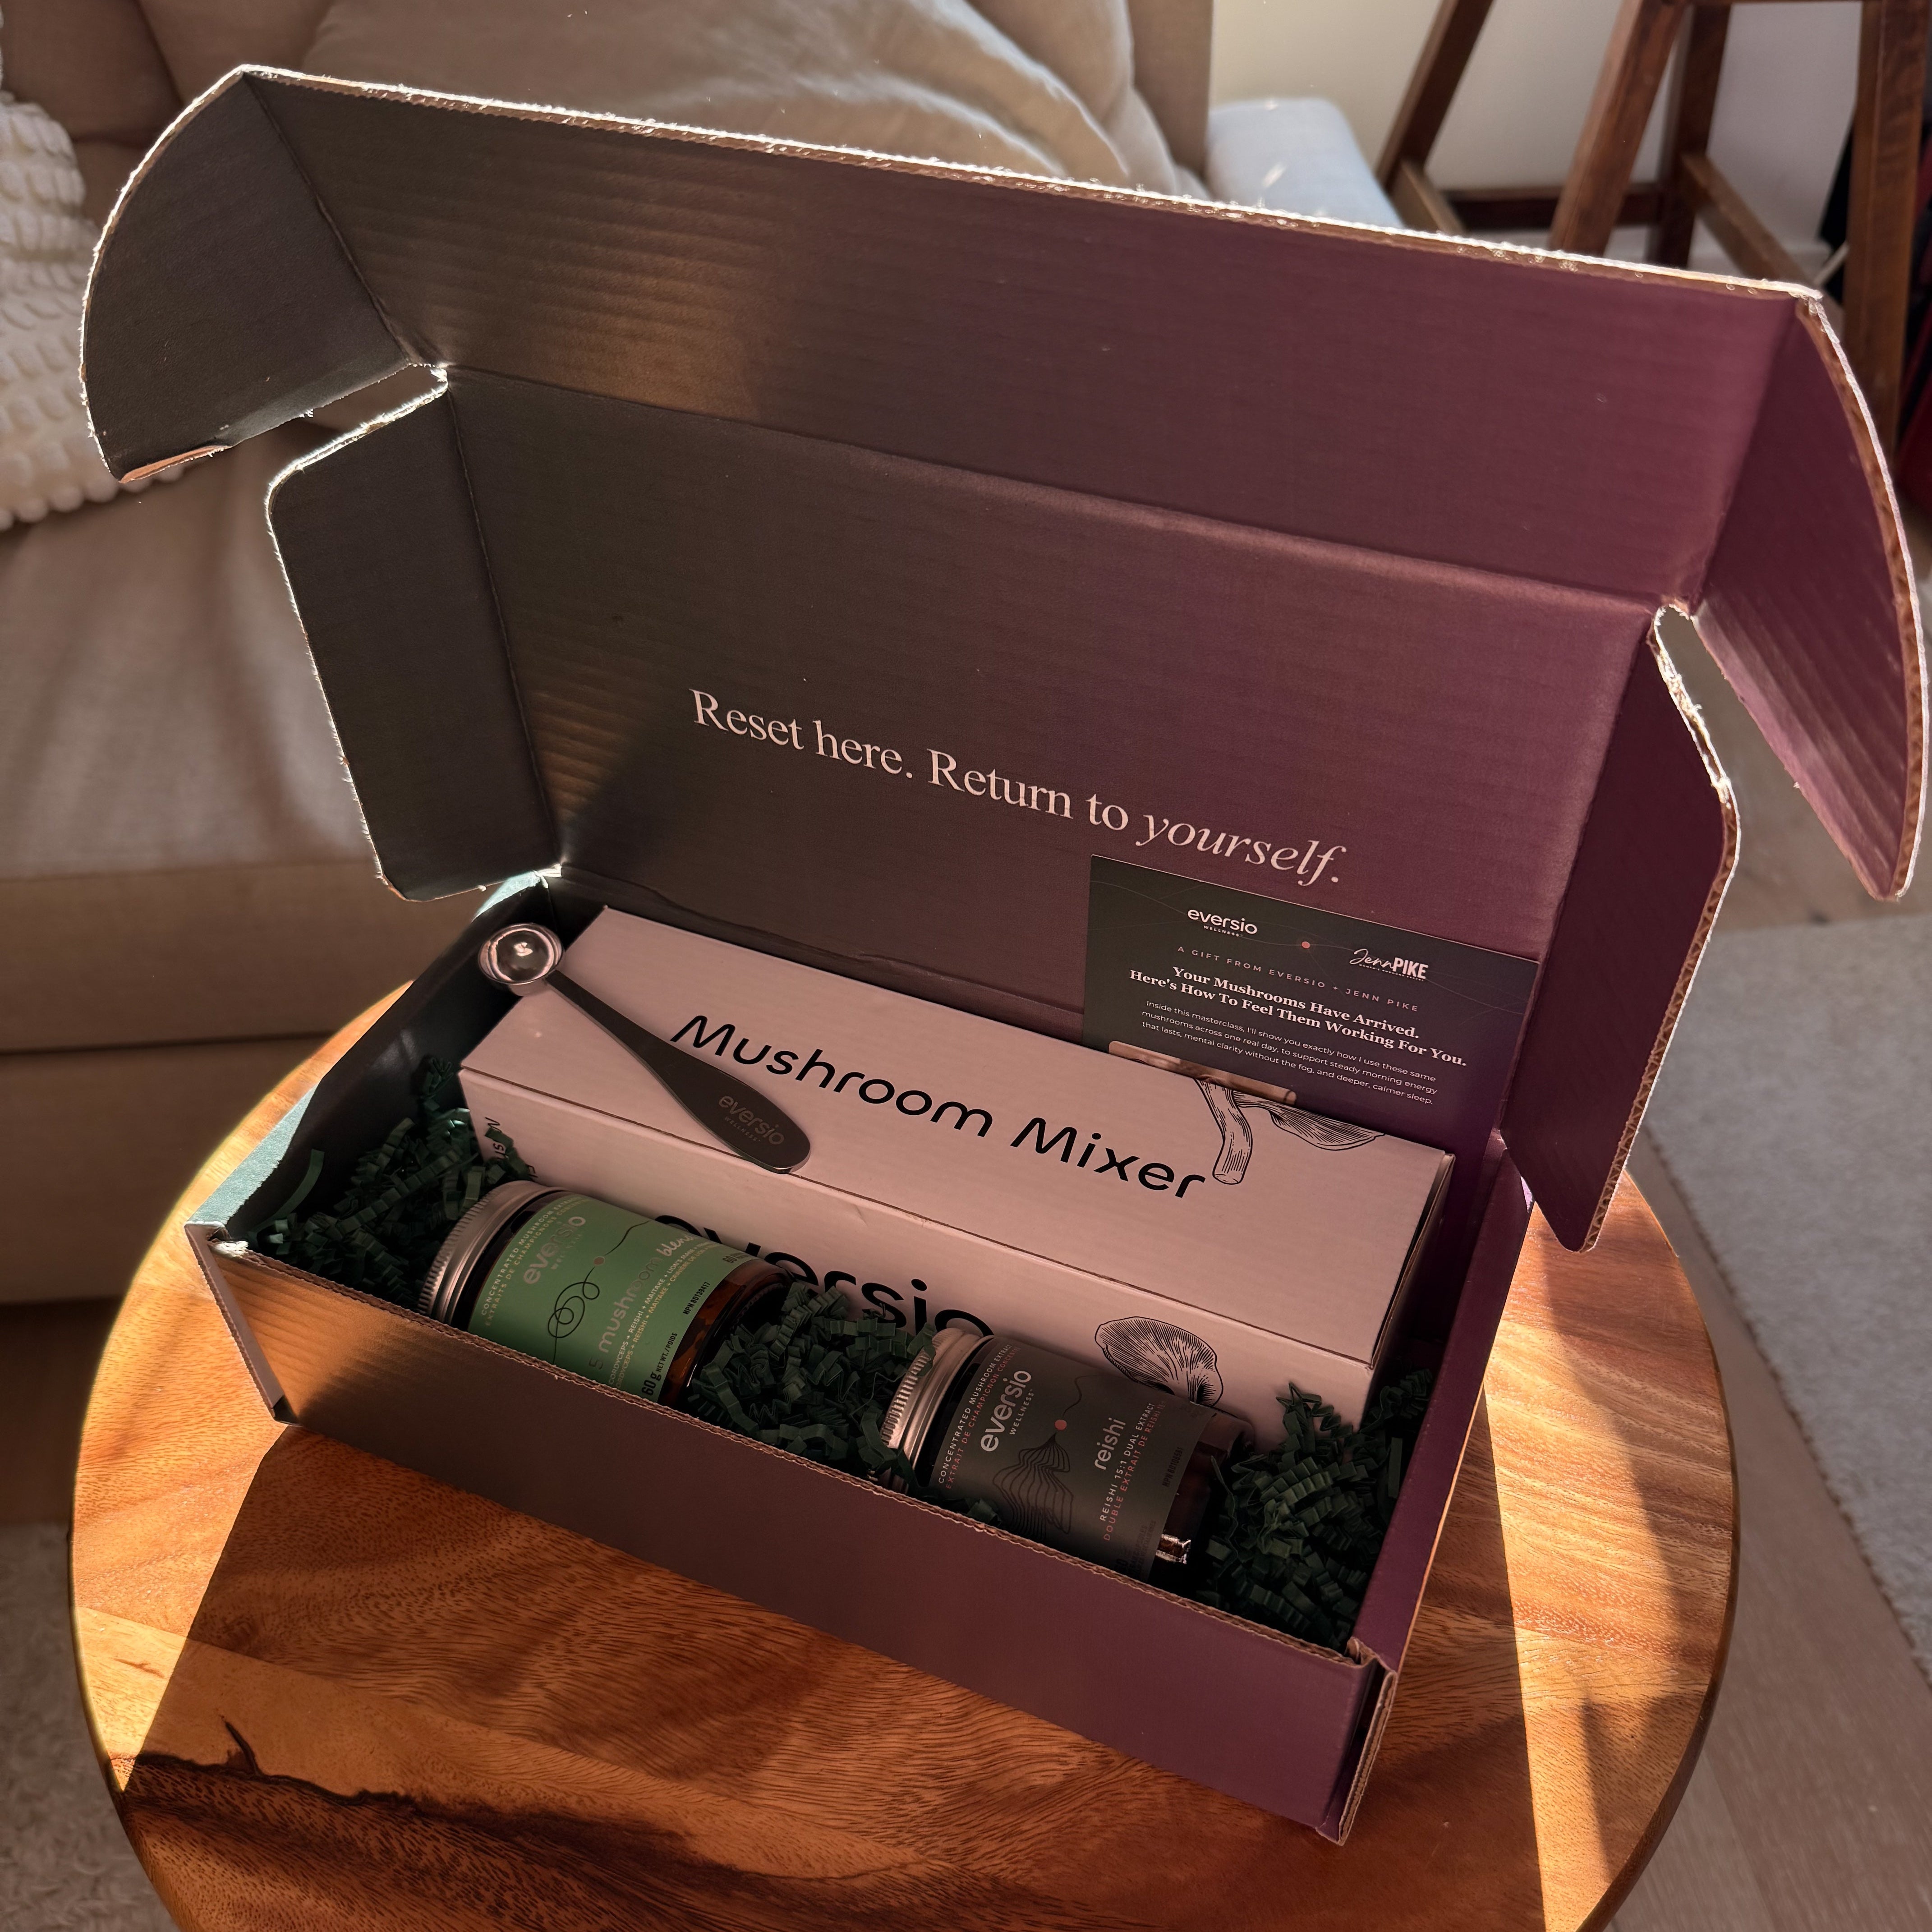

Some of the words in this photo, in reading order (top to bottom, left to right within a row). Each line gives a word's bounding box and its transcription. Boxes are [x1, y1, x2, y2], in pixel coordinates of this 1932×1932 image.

[690, 688, 804, 750] Reset
[813, 720, 913, 778] here.
[927, 749, 1074, 819] Return
[1086, 793, 1128, 830] to
[1136, 813, 1346, 886] yourself.
[1188, 910, 1257, 934] eversio
[1130, 970, 1177, 990] Here's
[1181, 983, 1216, 1000] How
[1219, 993, 1237, 1006] To
[1242, 999, 1273, 1016] Feel
[1277, 1009, 1320, 1028] Them
[1325, 1021, 1394, 1049] Working
[1398, 1040, 1427, 1055] For
[1430, 1048, 1466, 1066] You.
[1173, 966, 1210, 984] Your
[1214, 977, 1306, 1009] Mushrooms
[1309, 1002, 1350, 1020] Have
[1353, 1014, 1419, 1039] Arrived.
[1192, 950, 1219, 961] GIFT
[1227, 958, 1261, 972] FROM
[1269, 969, 1325, 988] EVERSIO
[1346, 989, 1379, 1002] JENN
[1387, 999, 1418, 1012] PIKE
[1142, 1011, 1193, 1029] mushrooms
[1195, 1026, 1222, 1037] across
[1224, 1033, 1241, 1042] one
[1243, 1038, 1259, 1046] real
[1293, 1052, 1328, 1065] support
[1330, 1061, 1360, 1074] steady
[1362, 1069, 1402, 1086] morning
[1405, 1081, 1437, 1095] energy
[1142, 1021, 1159, 1031] that
[1162, 1026, 1182, 1038] lasts,
[1184, 1033, 1214, 1046] mental
[1217, 1040, 1243, 1054] clarity
[1245, 1049, 1279, 1063] without
[1281, 1058, 1296, 1068] the
[1317, 1069, 1334, 1078] and
[1372, 1084, 1405, 1096] calmer
[1407, 1093, 1433, 1105] sleep.
[1146, 1000, 1172, 1012] Inside
[1174, 1007, 1190, 1017] this
[1192, 1013, 1245, 1033] masterclass,
[1258, 1031, 1282, 1041] show
[1283, 1038, 1301, 1047] you
[1302, 1043, 1334, 1056] exactly
[1337, 1050, 1357, 1061] how
[1382, 1063, 1408, 1074] these
[1410, 1072, 1436, 1082] same
[670, 1015, 993, 1137] Mushroom
[1010, 1117, 1205, 1199] Mixer
[718, 1096, 784, 1145] eversio
[481, 1248, 519, 1315] CONCENTRATED
[519, 1210, 554, 1246] MUSHROOM
[485, 1283, 507, 1327] EXTRAITS
[506, 1269, 515, 1279] DE
[514, 1216, 557, 1265] CHAMPIGNONS
[523, 1216, 586, 1284] eversio
[589, 1357, 603, 1370] 5
[598, 1257, 663, 1353] mushroom
[609, 1341, 629, 1384] CORDYCEPS
[628, 1311, 644, 1333] REISHI
[645, 1278, 665, 1304] MAITAKE
[616, 1350, 633, 1388] ORDYCEPS
[633, 1320, 648, 1343] REISHI
[649, 1287, 668, 1313] MAITAKE
[683, 1304, 695, 1315] NPN
[641, 1380, 656, 1396] 60
[650, 1371, 662, 1381] g
[656, 1362, 664, 1372] NET
[938, 1408, 971, 1483] CONCENTRATED
[969, 1362, 997, 1405] MUSHROOM
[980, 1371, 1032, 1452] eversio
[946, 1448, 964, 1489] EXTRAIT
[961, 1431, 971, 1444] DE
[968, 1374, 999, 1428] CHAMPIGNON
[1095, 1417, 1126, 1470] reishi
[1099, 1484, 1118, 1521] REISHI
[1114, 1460, 1127, 1479] 15:1
[1124, 1434, 1139, 1456] DUAL
[1136, 1403, 1155, 1431] EXTRACT
[1103, 1495, 1123, 1541] DOUBLE
[1120, 1450, 1141, 1491] EXTRAIT
[1138, 1435, 1148, 1447] DE
[1145, 1409, 1160, 1433] REISHI
